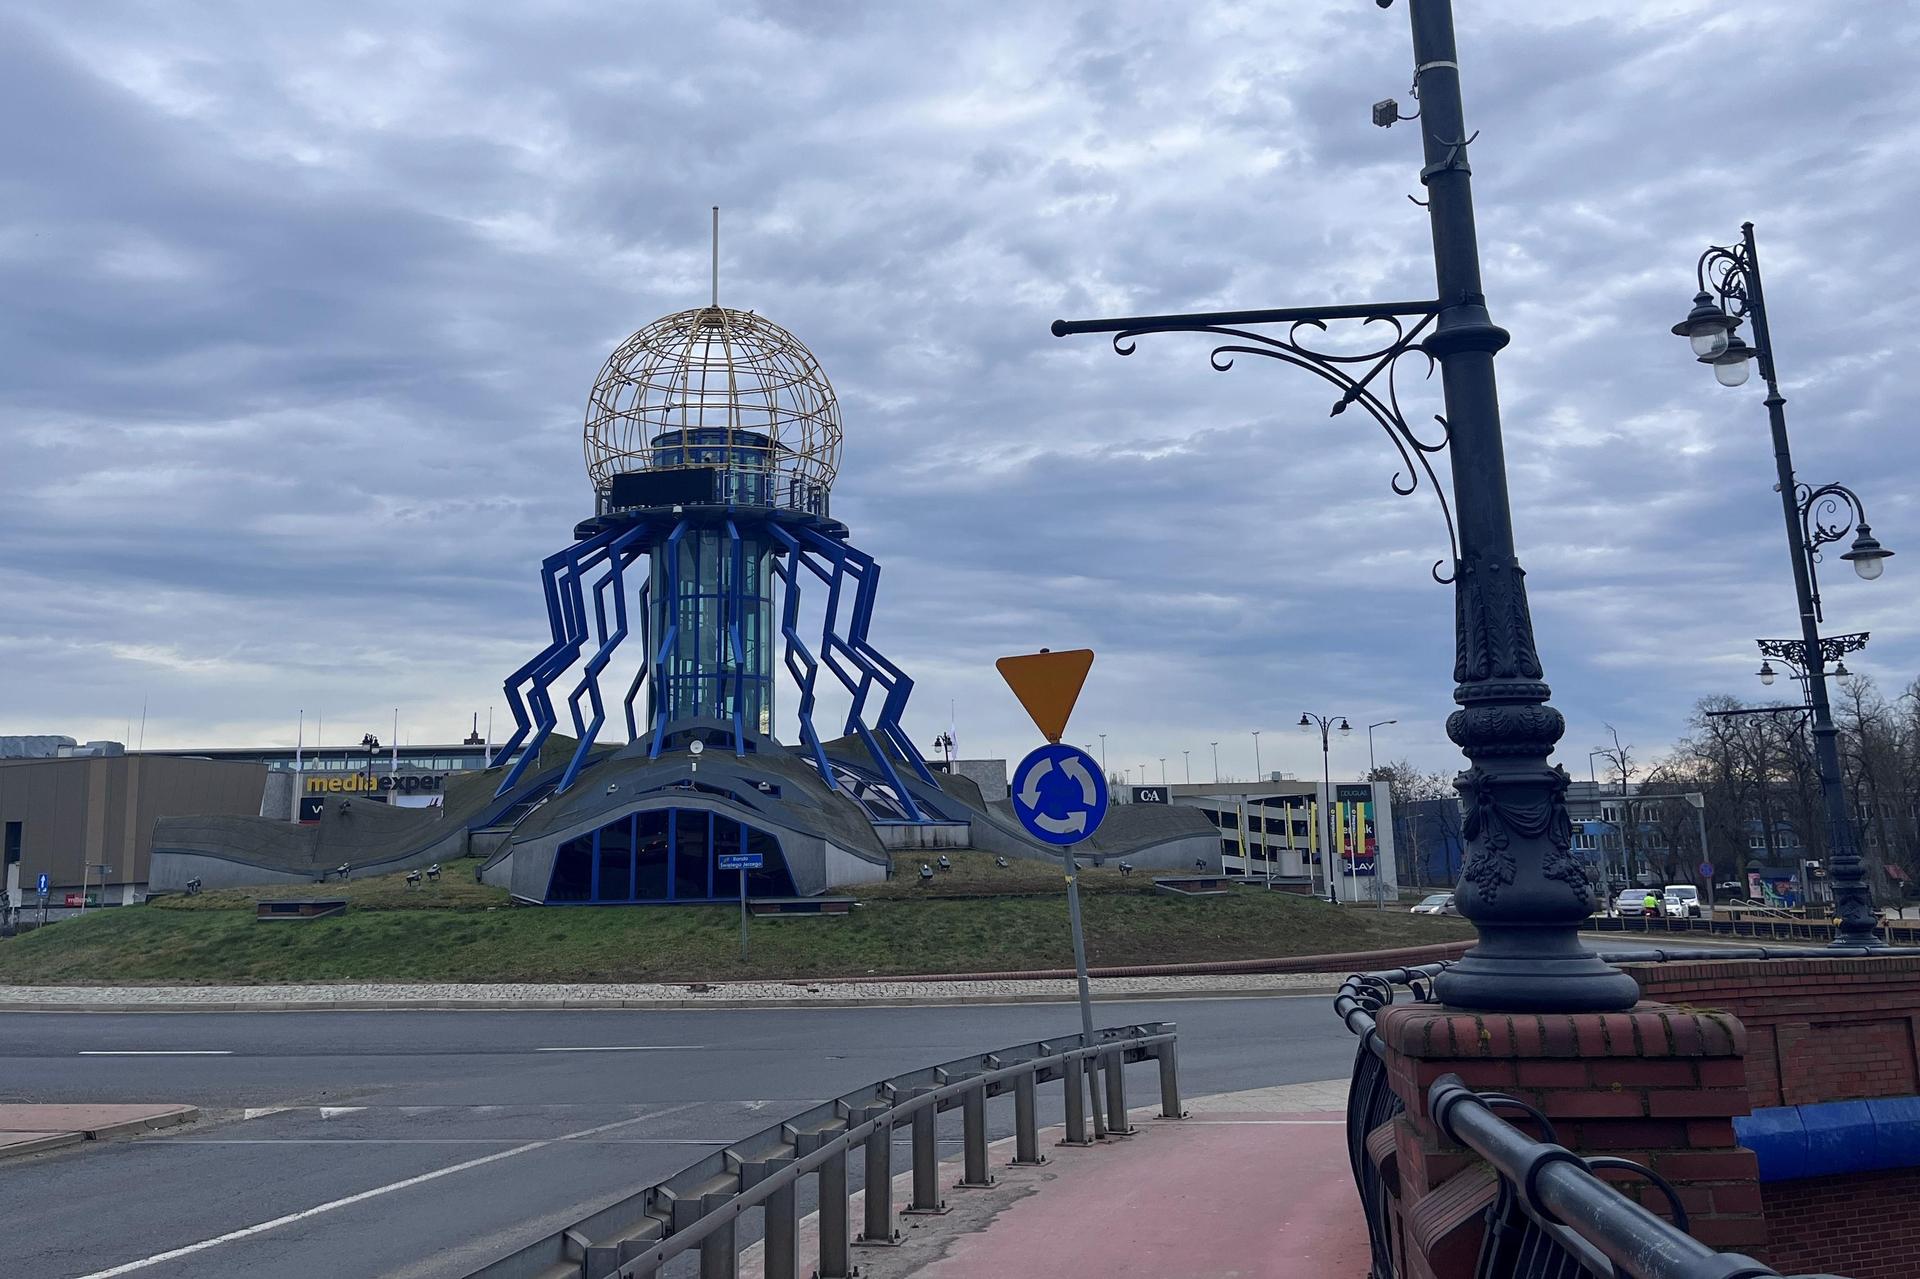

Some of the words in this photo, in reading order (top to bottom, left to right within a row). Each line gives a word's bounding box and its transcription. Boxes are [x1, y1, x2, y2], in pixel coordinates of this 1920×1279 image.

[306, 773, 443, 792] mediaexper
[1140, 790, 1160, 801] C&A
[1346, 862, 1375, 870] PLAY
